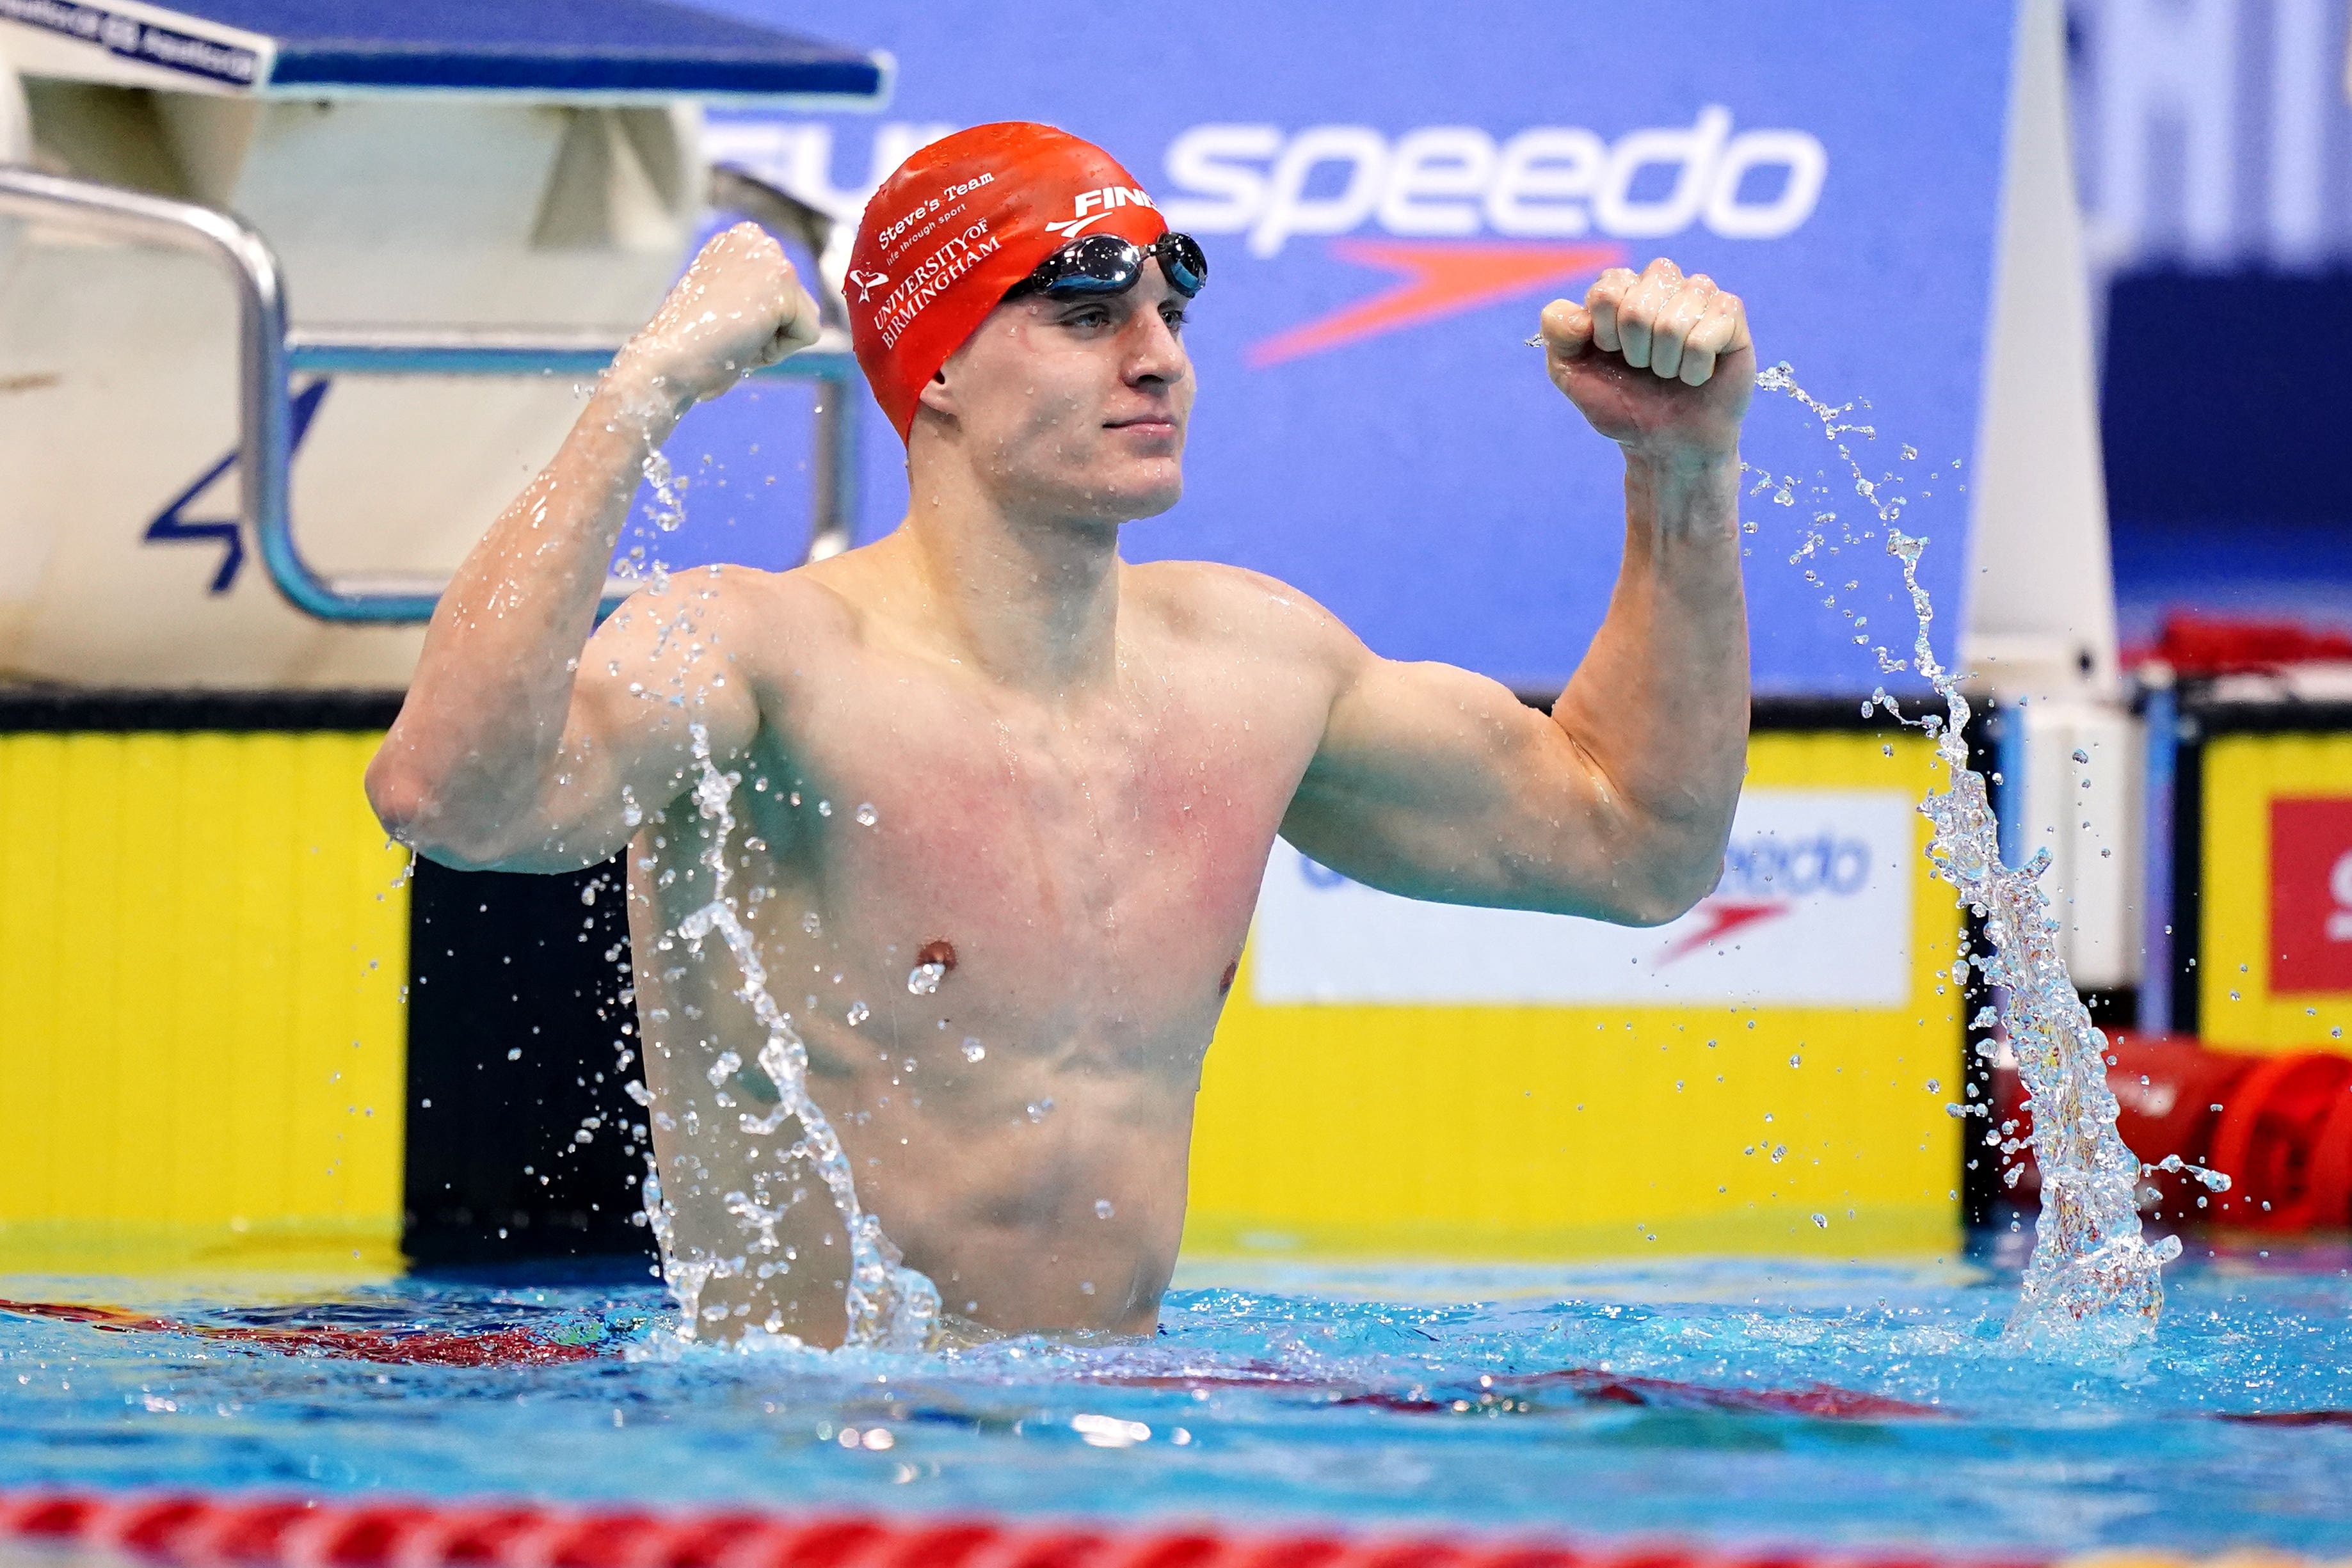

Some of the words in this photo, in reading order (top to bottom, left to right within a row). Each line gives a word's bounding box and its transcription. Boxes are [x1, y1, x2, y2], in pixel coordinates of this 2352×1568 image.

[879, 198, 940, 250] Steve's
[943, 172, 995, 202] Team
[900, 221, 936, 252] through
[938, 203, 966, 224] sport
[1161, 105, 1828, 257] speedo
[874, 229, 970, 330] UNIVERSITY
[881, 236, 1002, 349] BIRMINGHAM
